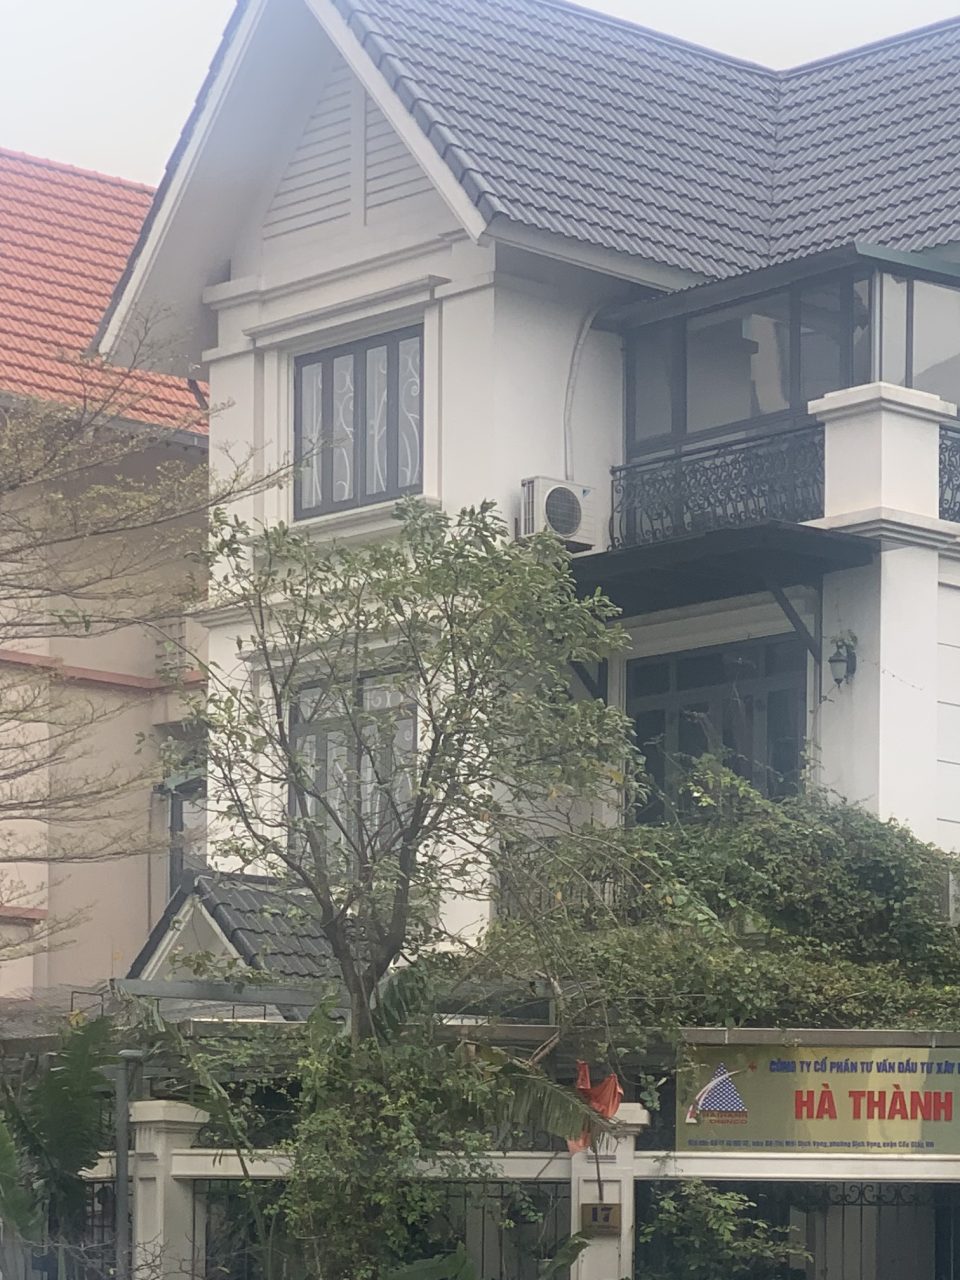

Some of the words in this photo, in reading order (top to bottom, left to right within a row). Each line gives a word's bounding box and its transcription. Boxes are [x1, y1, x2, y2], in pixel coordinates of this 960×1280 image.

[769, 1058, 796, 1073] CÔNG
[800, 1060, 811, 1073] TY
[860, 1060, 874, 1073] TƯ
[876, 1058, 895, 1073] VẤN
[920, 1061, 934, 1074] TƯ
[936, 1060, 955, 1074] XÂY
[795, 1083, 838, 1120] HÀ
[848, 1083, 953, 1121] THÀNH
[592, 1206, 613, 1222] 17
